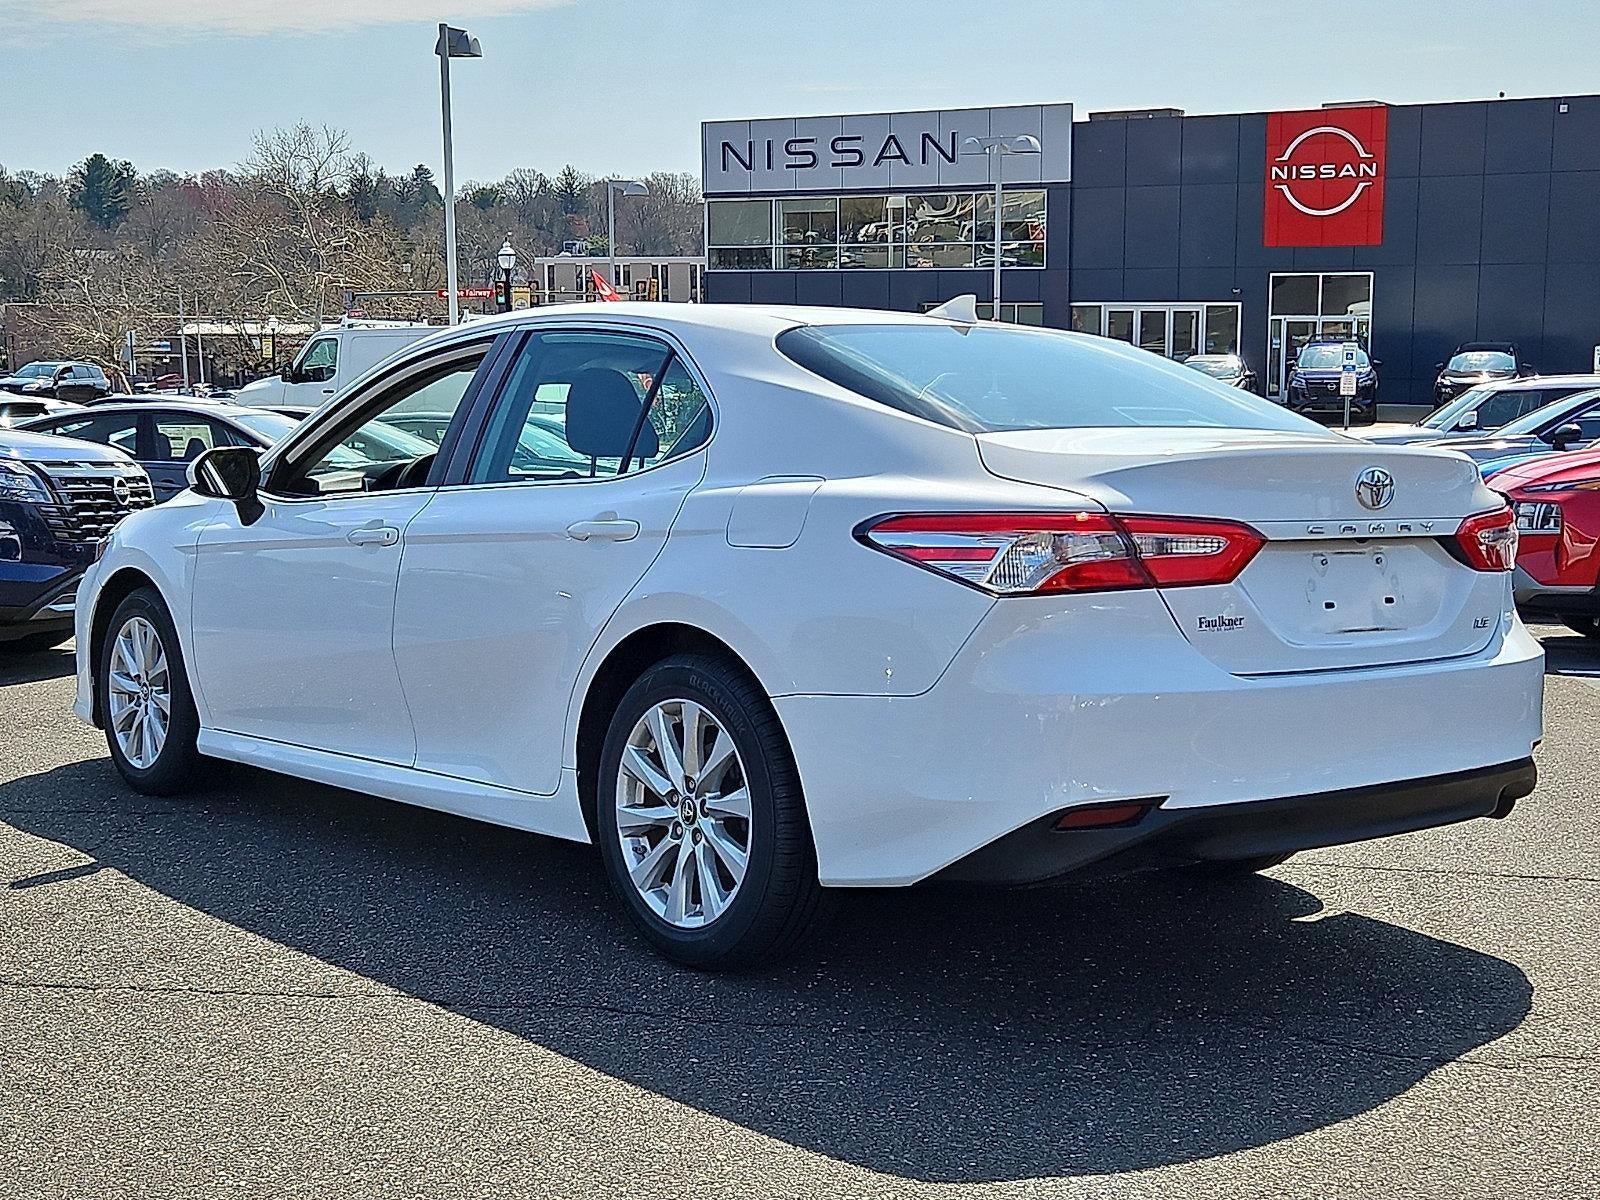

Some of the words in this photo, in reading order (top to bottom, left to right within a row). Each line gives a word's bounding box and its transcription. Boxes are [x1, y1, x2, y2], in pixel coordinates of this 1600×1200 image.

[720, 131, 959, 172] NISSAN
[1271, 162, 1377, 180] NISSAN
[1307, 522, 1434, 534] CAMRY
[1198, 615, 1245, 629] Faulkner
[1473, 616, 1490, 629] LE
